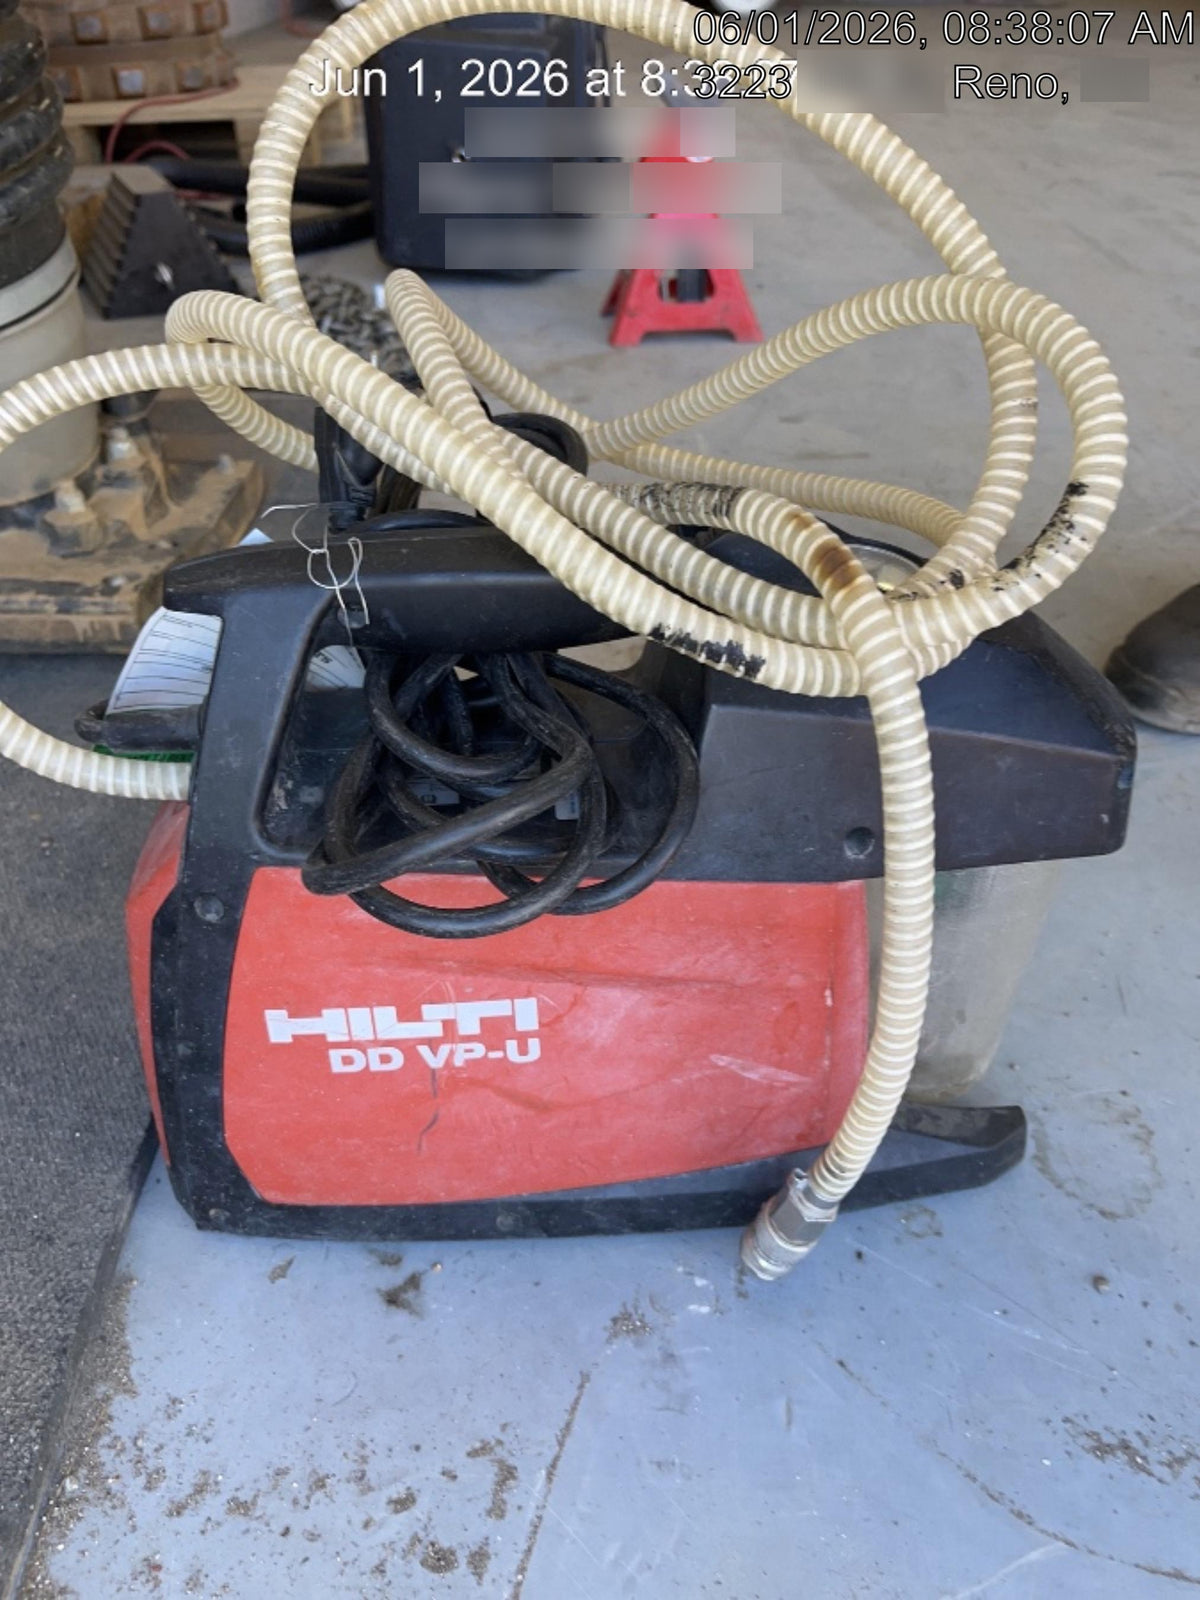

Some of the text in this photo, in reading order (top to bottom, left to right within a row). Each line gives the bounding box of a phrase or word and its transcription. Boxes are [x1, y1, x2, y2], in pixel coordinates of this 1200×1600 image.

[264, 997, 539, 1044] HILTI
[328, 1037, 542, 1074] DD VP-U
